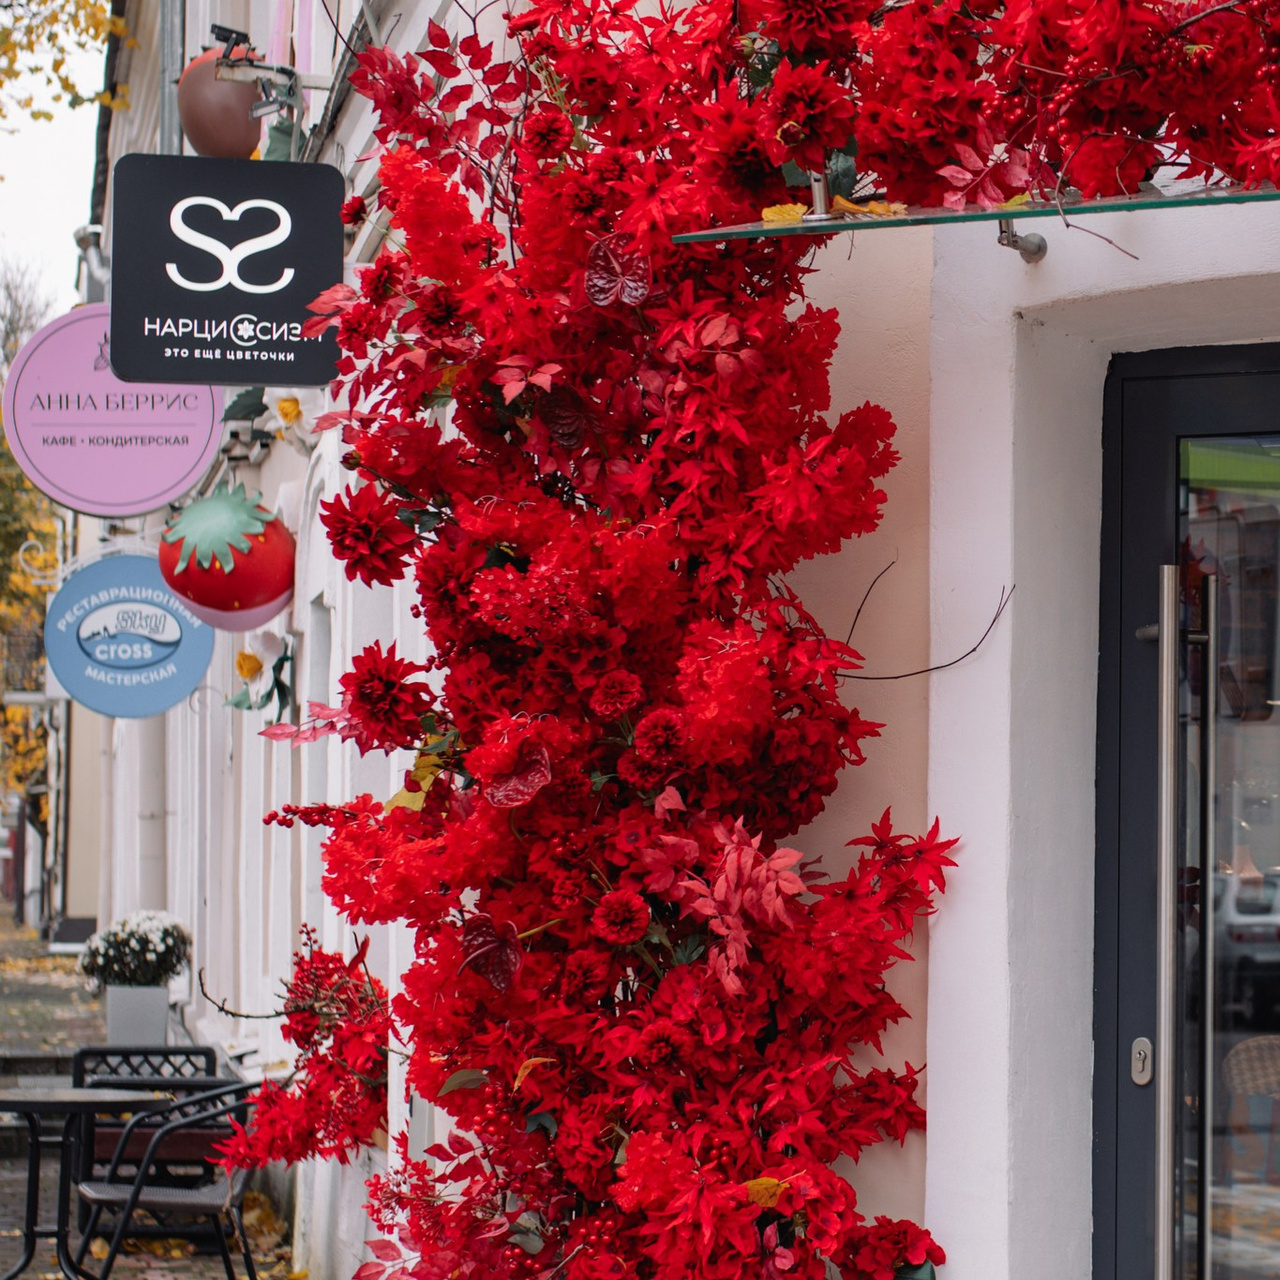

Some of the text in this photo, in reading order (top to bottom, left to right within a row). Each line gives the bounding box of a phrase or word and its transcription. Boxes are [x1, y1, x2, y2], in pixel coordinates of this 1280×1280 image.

[144, 314, 322, 346] НАРЦИССИЗ
[164, 348, 189, 358] ЭТО
[226, 350, 295, 362] ЦВЕТОЧКИ
[30, 393, 199, 411] АННА БЕРРИС
[42, 435, 189, 448] КАФЕ КОНДИТЕРСКАЯ
[85, 662, 177, 686] МАСТЕРСКАЯ
